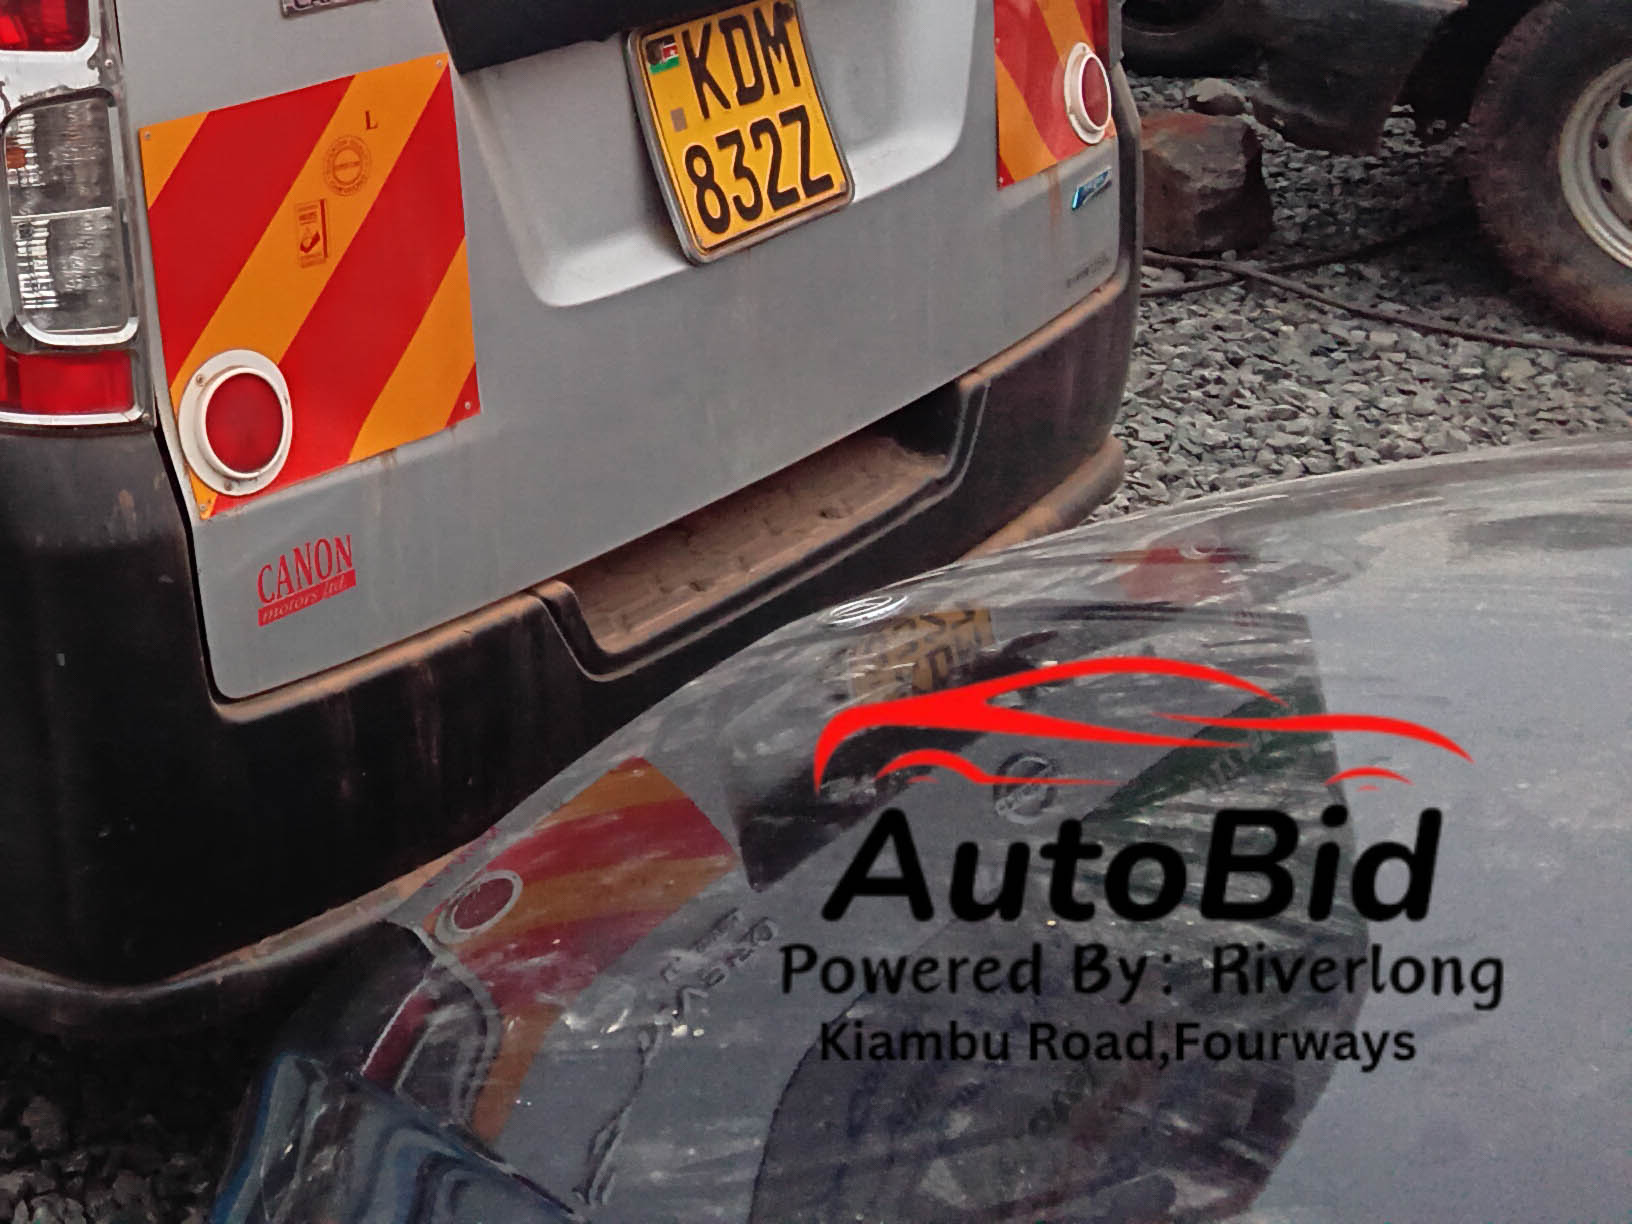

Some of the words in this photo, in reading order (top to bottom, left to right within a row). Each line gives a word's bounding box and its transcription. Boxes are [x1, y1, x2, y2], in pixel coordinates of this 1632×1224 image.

[681, 6, 801, 120] KDM
[365, 110, 378, 131] L
[684, 105, 834, 235] 832Z
[257, 534, 353, 604] CANON
